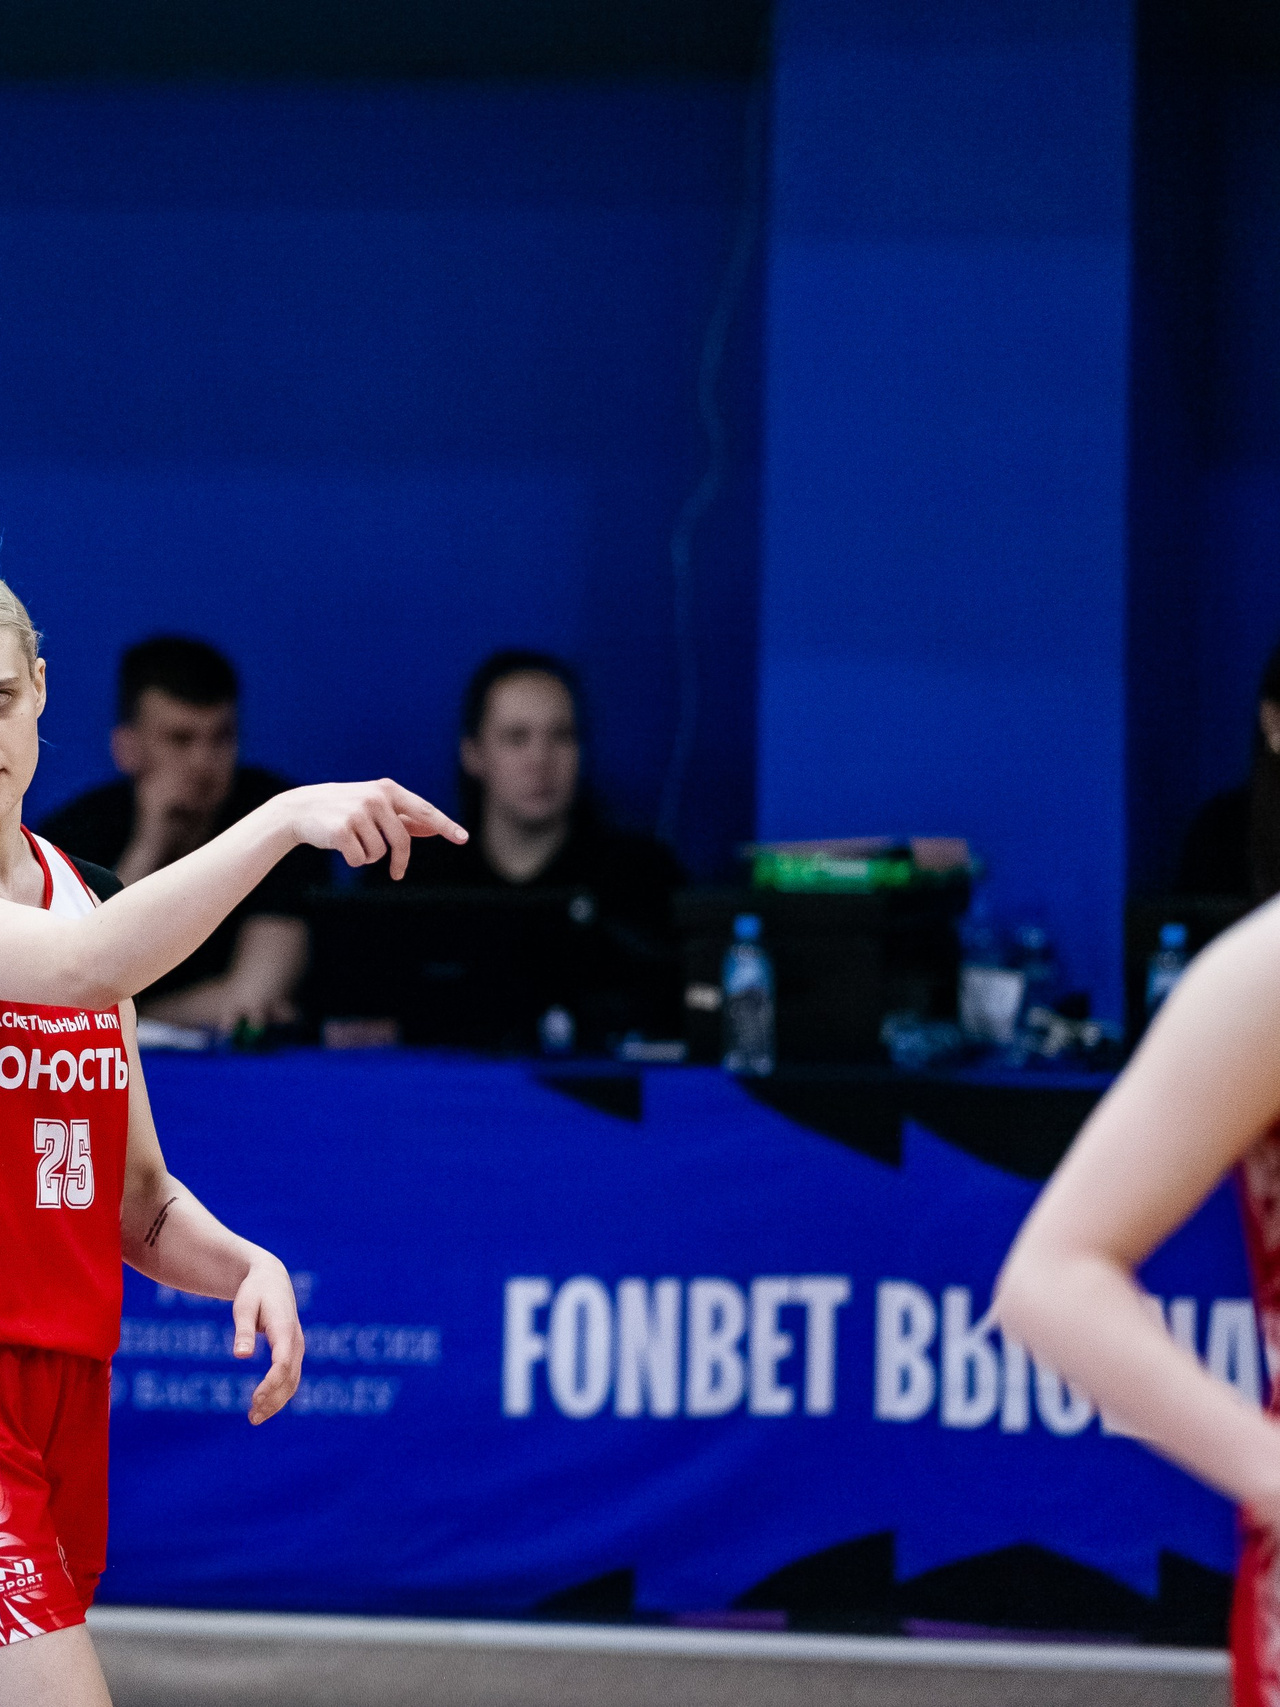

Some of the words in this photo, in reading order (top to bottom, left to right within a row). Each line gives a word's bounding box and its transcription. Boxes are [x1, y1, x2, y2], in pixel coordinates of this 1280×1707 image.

[94, 1013, 120, 1030] КЛУ
[33, 1117, 95, 1210] 25
[502, 1274, 852, 1419] FONBET
[873, 1278, 1264, 1437] ВЫСА
